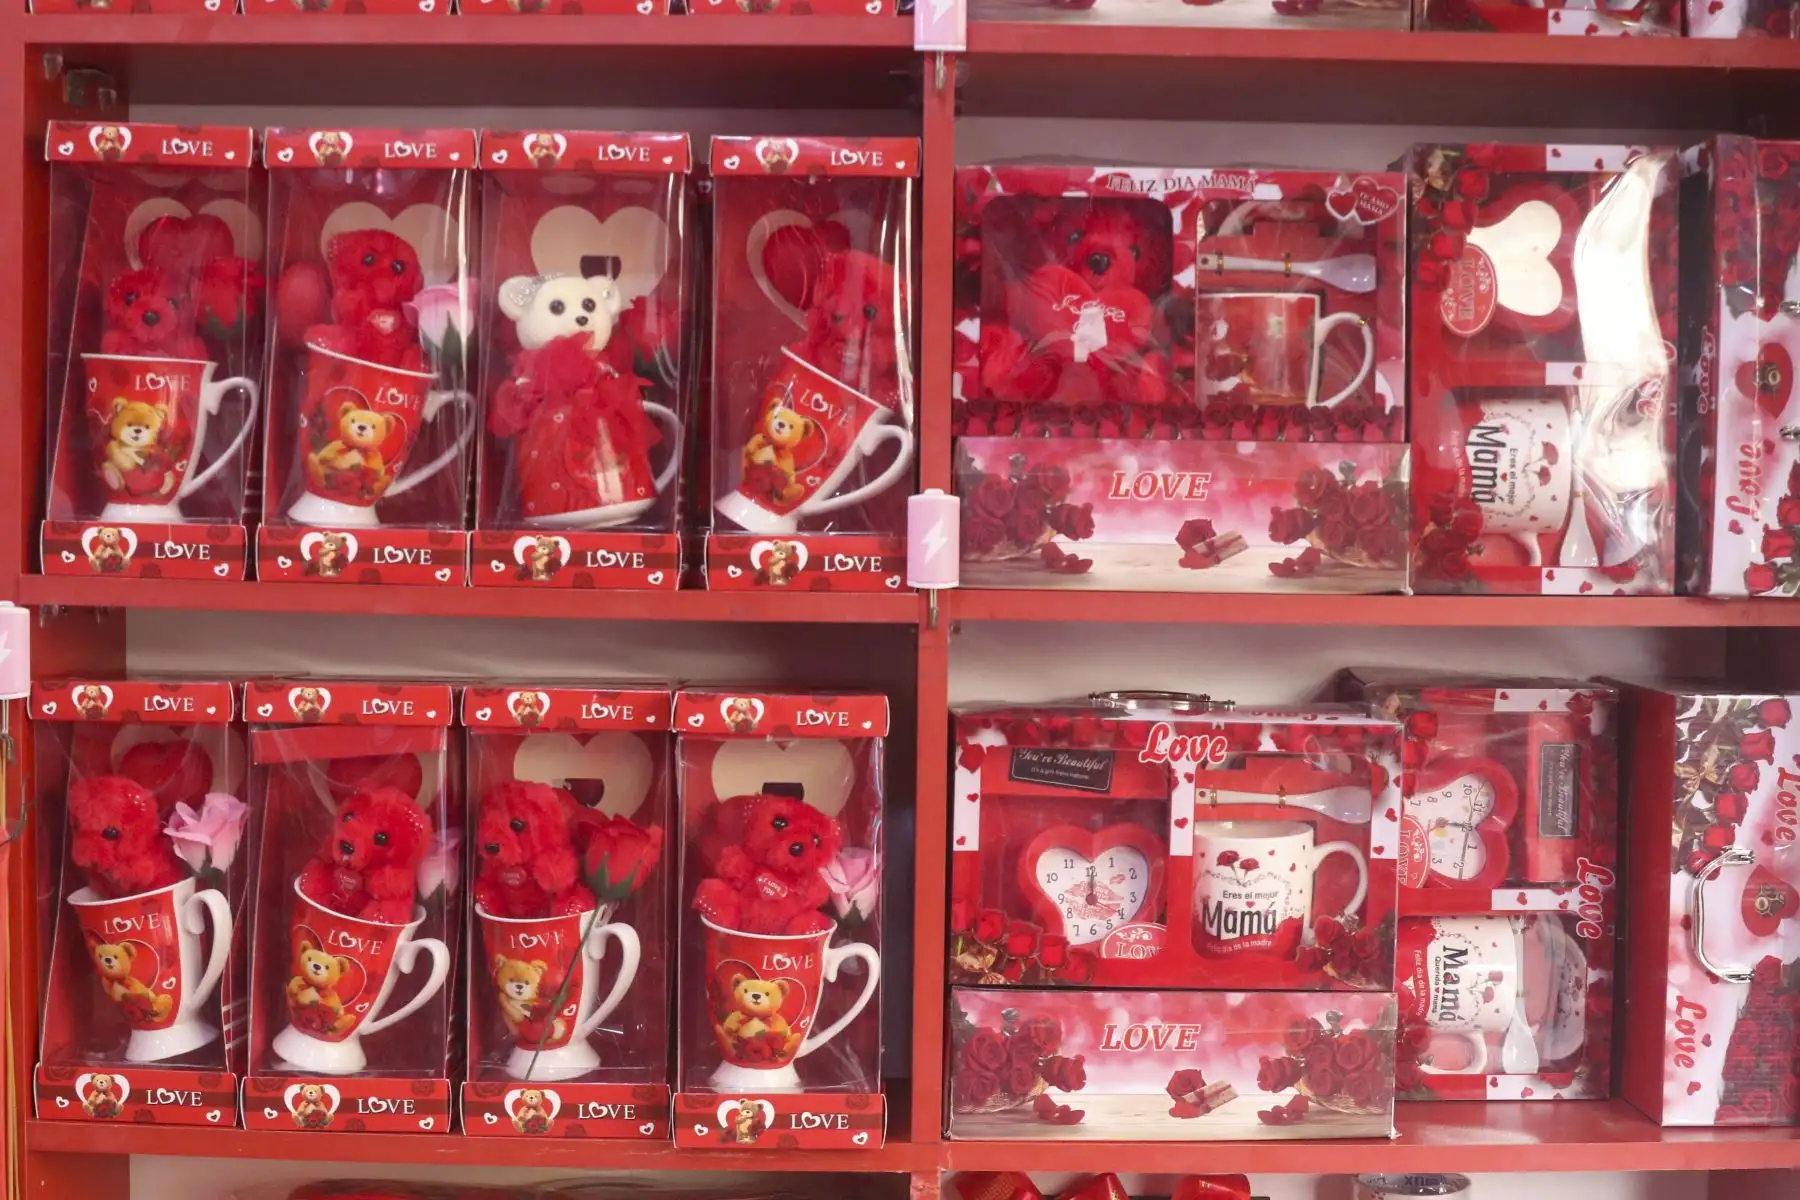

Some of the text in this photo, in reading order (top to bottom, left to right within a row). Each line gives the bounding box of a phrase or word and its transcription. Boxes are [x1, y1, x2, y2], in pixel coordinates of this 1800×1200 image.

[162, 137, 213, 157] LOVE
[384, 140, 437, 159] LOVE
[598, 144, 650, 163] LOVE
[831, 148, 883, 167] LOVE
[1107, 174, 1158, 194] FELIZ
[1164, 175, 1195, 190] DIA
[135, 372, 190, 391] LOVE
[799, 387, 854, 431] LOVE
[1109, 471, 1212, 501] LOVE
[154, 540, 211, 560] LOVE
[374, 545, 432, 566] LOVE
[586, 549, 645, 569] LOVE
[823, 553, 882, 573] LOVE
[144, 694, 195, 713] LOVE
[362, 698, 414, 716] LOVE
[581, 702, 634, 721] LOVE
[796, 708, 849, 727] LOVE
[1138, 721, 1229, 764] Love
[1064, 858, 1074, 869] 11
[1108, 857, 1115, 868] 1
[1046, 872, 1058, 883] 10
[1128, 867, 1138, 880] 2
[1057, 893, 1065, 905] 9
[1129, 891, 1137, 903] 3
[1222, 890, 1242, 900] Eres
[1244, 891, 1253, 900] el
[1576, 857, 1616, 939] Love
[1066, 907, 1074, 919] 8
[1201, 900, 1277, 940] Mamá
[104, 912, 161, 937] LOVE
[1073, 924, 1080, 937] 7
[1089, 923, 1097, 935] 6
[1106, 918, 1113, 930] 5
[328, 929, 383, 956] LOVE
[1116, 942, 1161, 959] LOV
[762, 952, 815, 972] LOVE
[1438, 945, 1469, 1021] Mamá
[1099, 1022, 1203, 1053] LOVE
[1673, 995, 1707, 1069] Love
[146, 1087, 203, 1107] LOVE
[357, 1096, 415, 1115] LOVE
[578, 1102, 636, 1121] LOVE
[790, 1111, 849, 1130] LOVE
